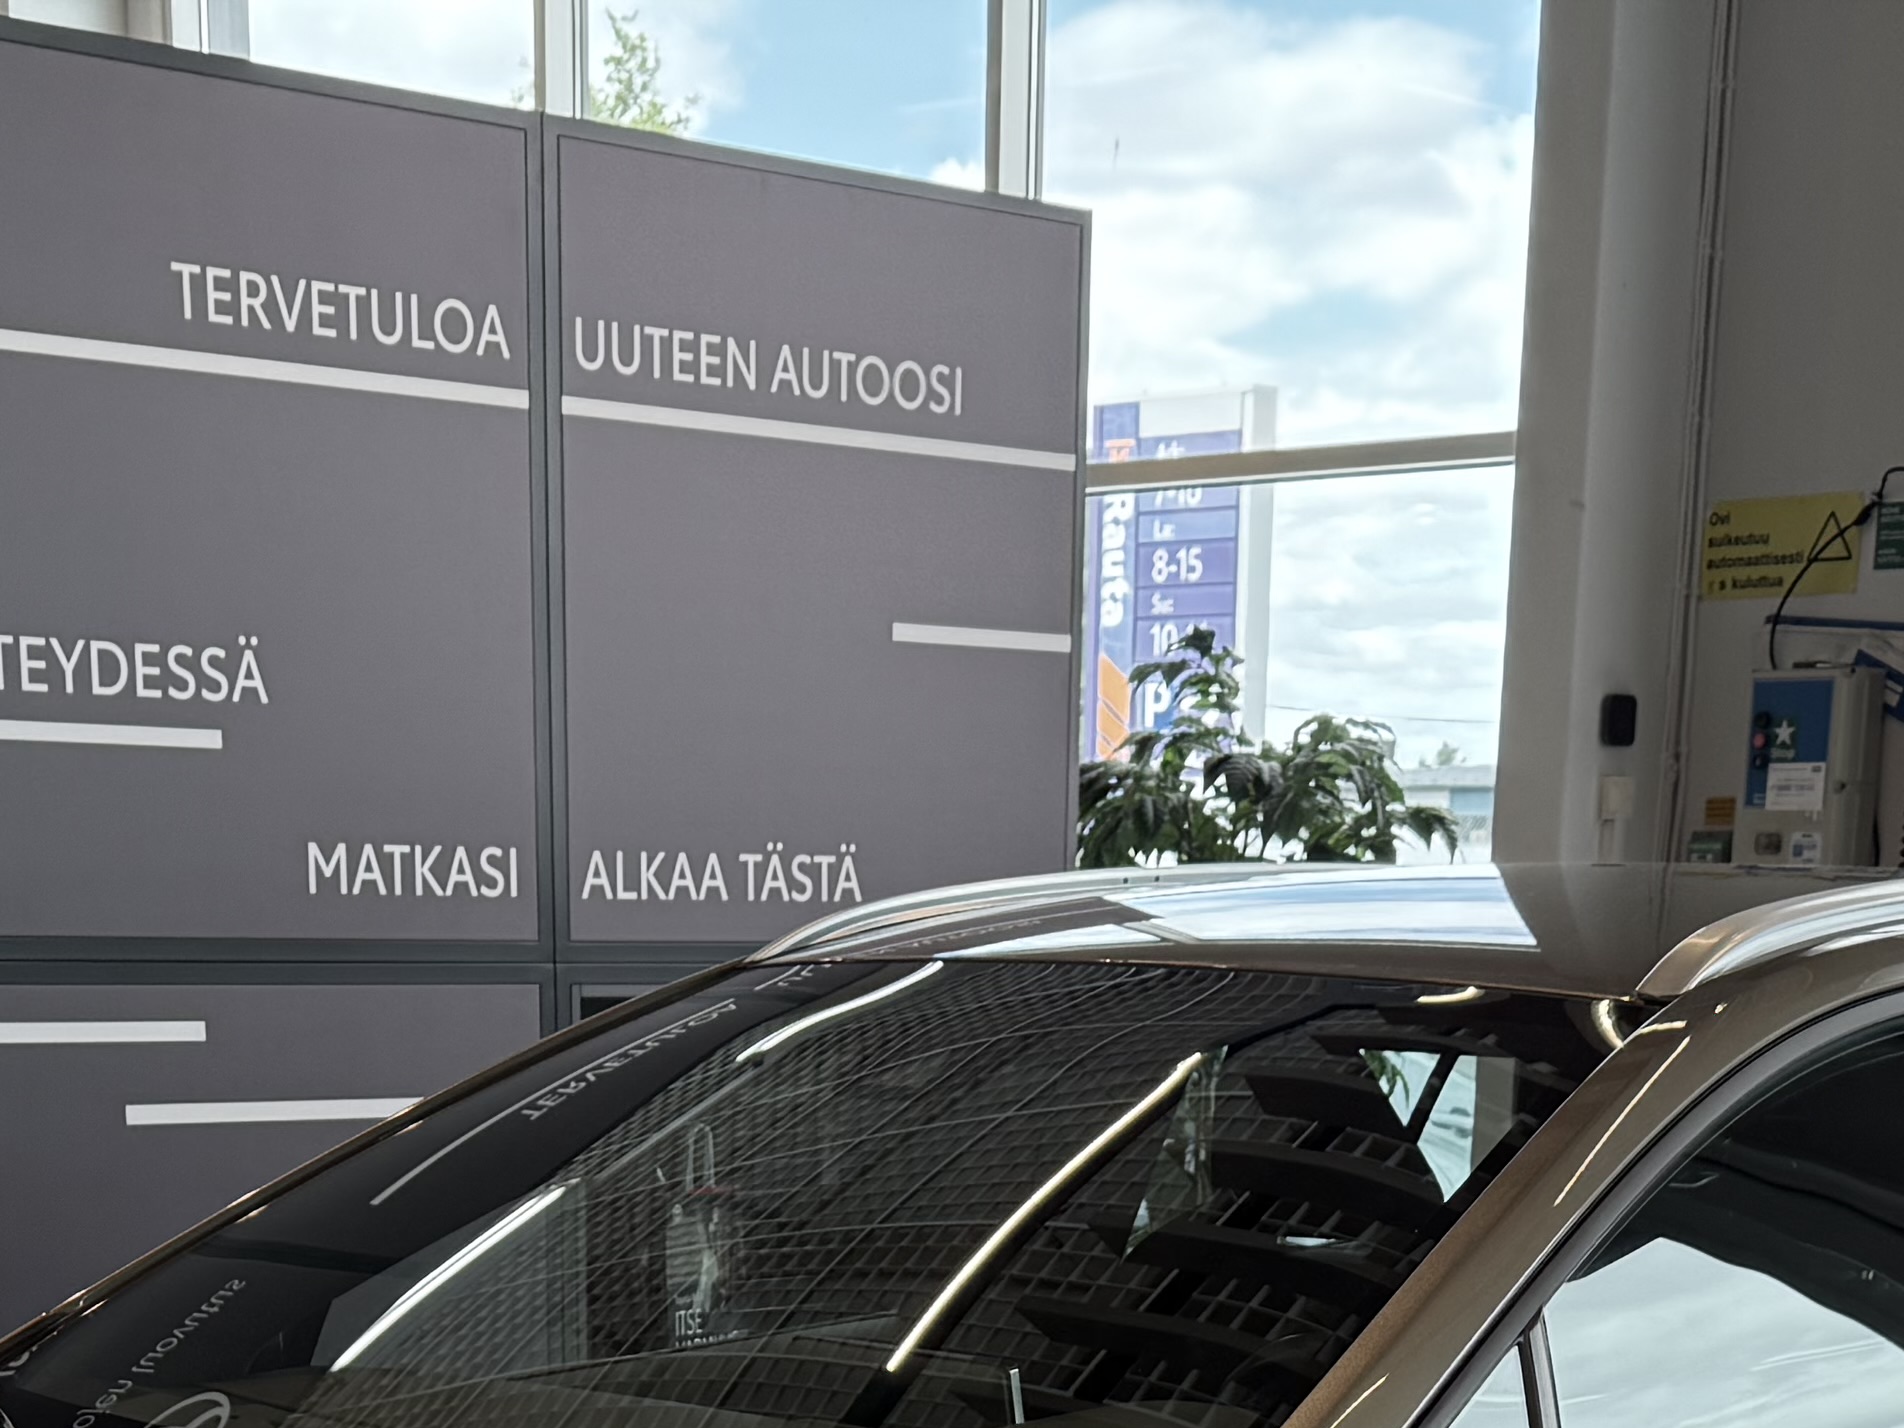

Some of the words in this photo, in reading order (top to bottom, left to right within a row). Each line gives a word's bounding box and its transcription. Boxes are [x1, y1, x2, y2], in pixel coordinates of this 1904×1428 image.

[170, 260, 511, 361] TERVETULOA
[572, 316, 757, 393] UUTEEN
[769, 343, 964, 417] AUTOOSI
[1709, 511, 1731, 526] Ovi
[1151, 546, 1203, 583] 8-15
[306, 840, 519, 899] MATKASI
[581, 849, 729, 902] ALKAA
[739, 841, 862, 902] TÄSTÄ
